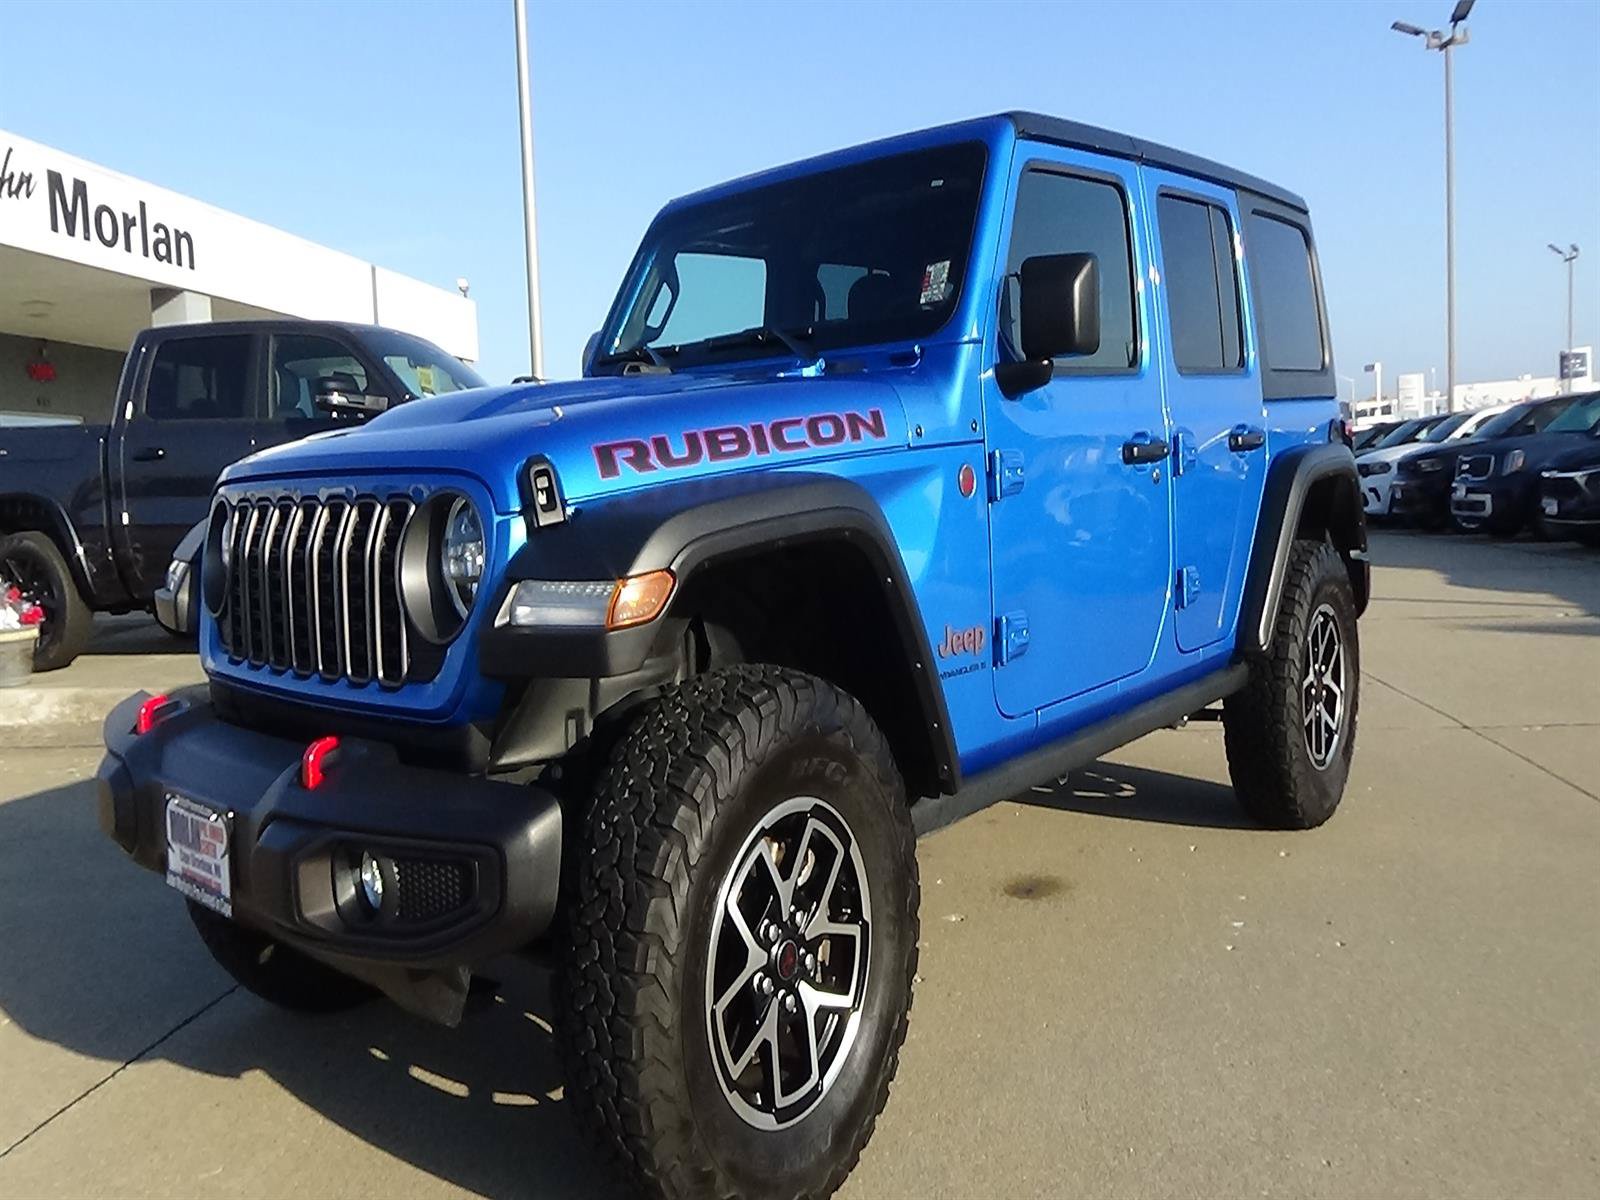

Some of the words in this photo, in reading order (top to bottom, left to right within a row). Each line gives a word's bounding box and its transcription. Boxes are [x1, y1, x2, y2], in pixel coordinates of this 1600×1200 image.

[47, 168, 196, 271] Morlan
[591, 408, 888, 480] RUBICON
[937, 624, 985, 659] Jeep
